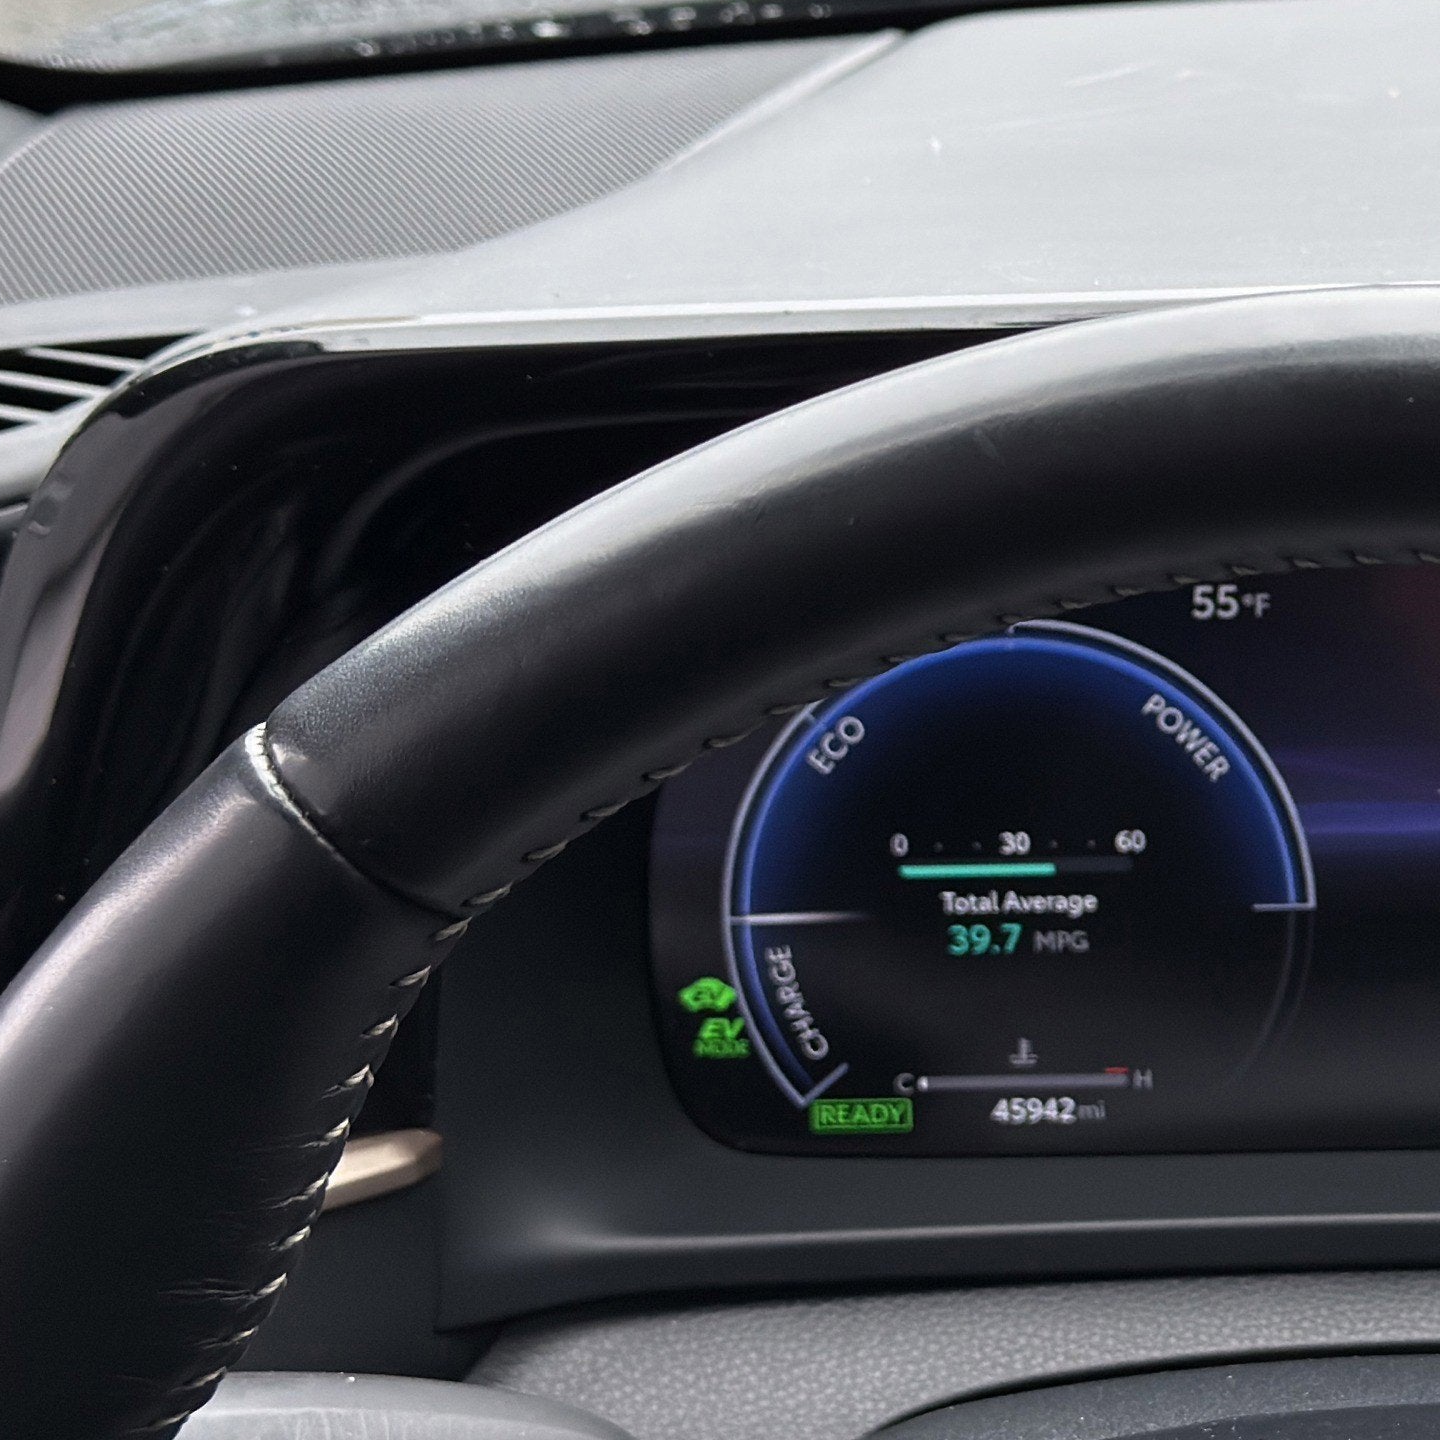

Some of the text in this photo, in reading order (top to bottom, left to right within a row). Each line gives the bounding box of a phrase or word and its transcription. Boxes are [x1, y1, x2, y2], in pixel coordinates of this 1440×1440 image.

[809, 715, 866, 775] ECO
[1140, 693, 1231, 784] POWER
[889, 829, 1147, 858] 0 30 60
[939, 889, 1100, 918] Total Average
[945, 922, 1091, 957] 39.7 MPG
[764, 944, 830, 1061] CHARGE
[818, 1103, 906, 1126] READY
[990, 1096, 1079, 1126] 45942
